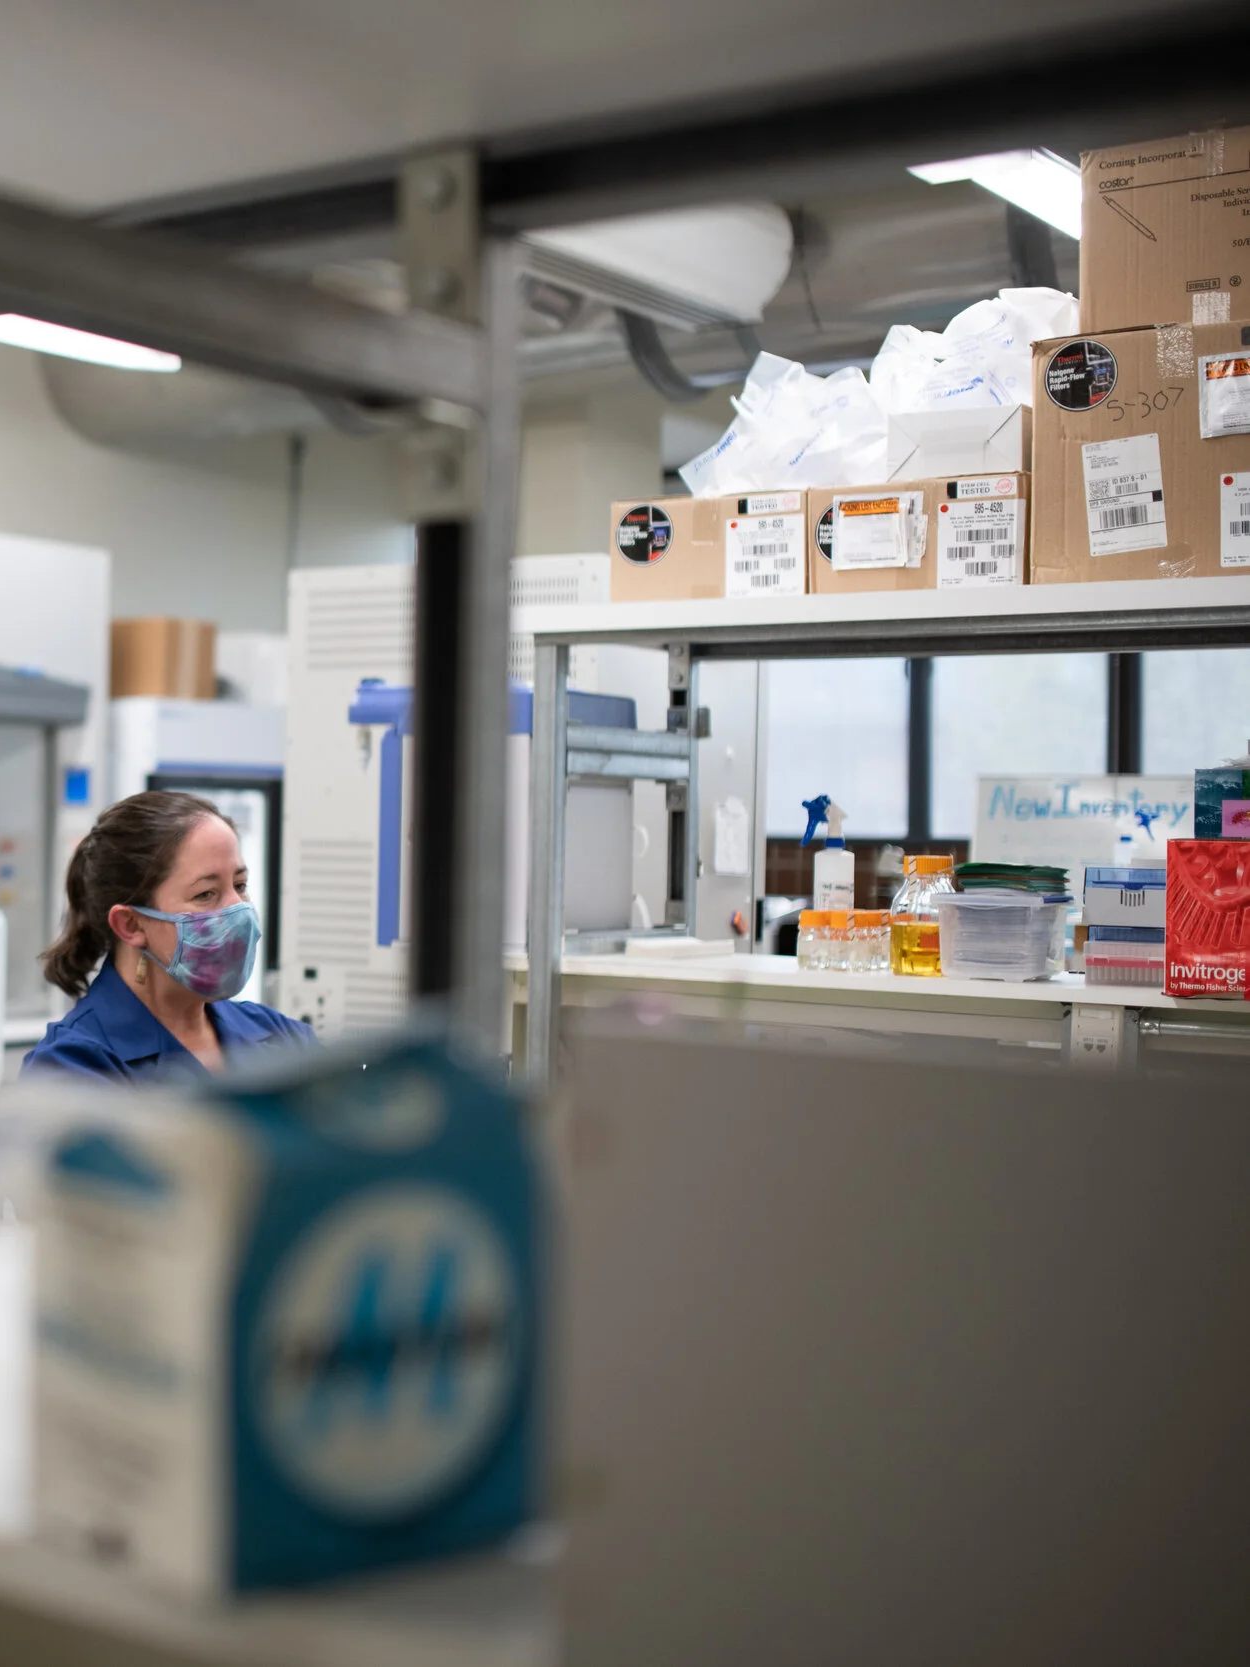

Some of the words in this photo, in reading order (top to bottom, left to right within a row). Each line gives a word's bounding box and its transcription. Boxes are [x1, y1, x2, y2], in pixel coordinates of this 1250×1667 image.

[1099, 159, 1136, 170] Corning
[1138, 146, 1199, 163] Incorporat
[1190, 188, 1235, 202] Disposable
[1049, 367, 1075, 377] Nalgene
[1049, 373, 1086, 384] Rapid-Flow
[1050, 383, 1070, 391] Filters
[961, 487, 990, 495] TESTED
[974, 501, 1004, 514] 595-4520
[1170, 981, 1178, 990] by
[1179, 981, 1205, 990] Thermo
[1206, 983, 1227, 991] Fisher
